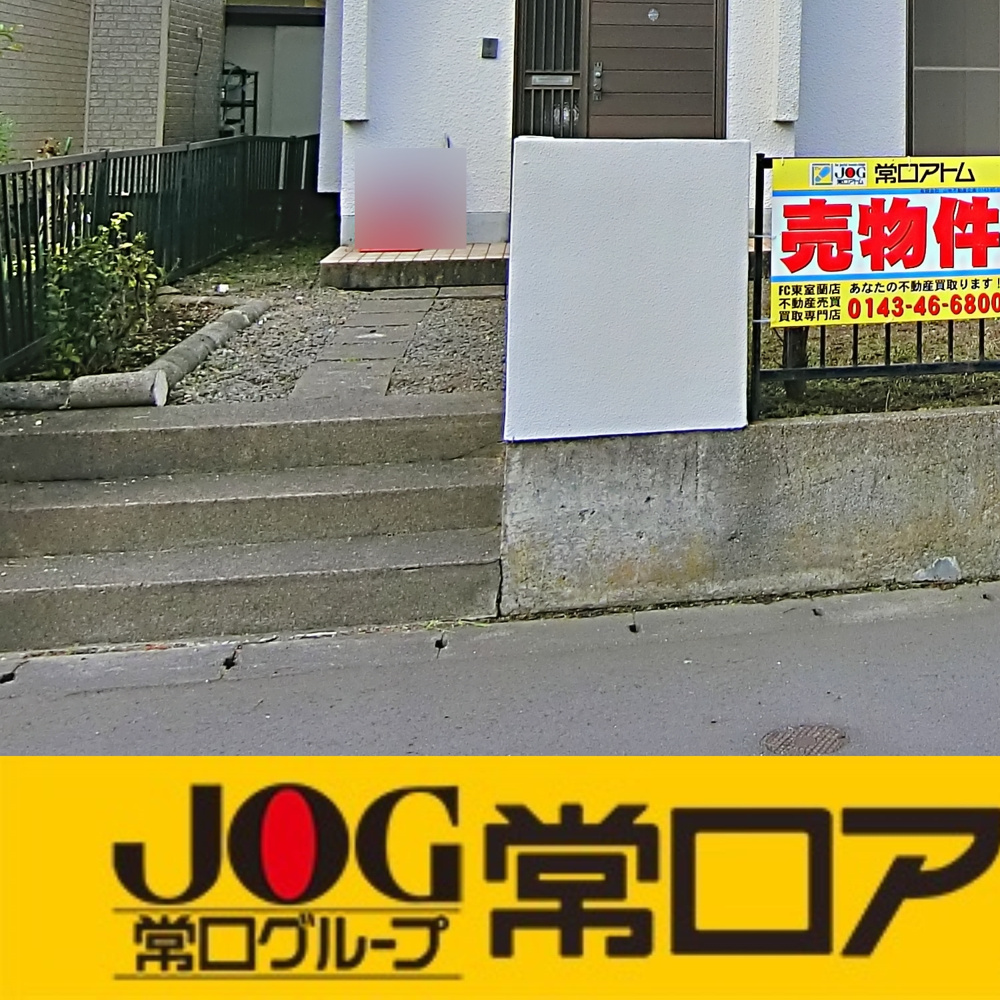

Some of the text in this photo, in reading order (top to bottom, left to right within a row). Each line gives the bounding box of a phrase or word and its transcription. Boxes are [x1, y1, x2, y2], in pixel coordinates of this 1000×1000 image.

[834, 167, 866, 179] JOG
[874, 162, 976, 184] 常口アトム
[780, 196, 1000, 273] 売物件
[778, 283, 841, 297] FC東室蘭店
[778, 296, 841, 309] 不動産売買
[778, 309, 841, 323] 買取専門店
